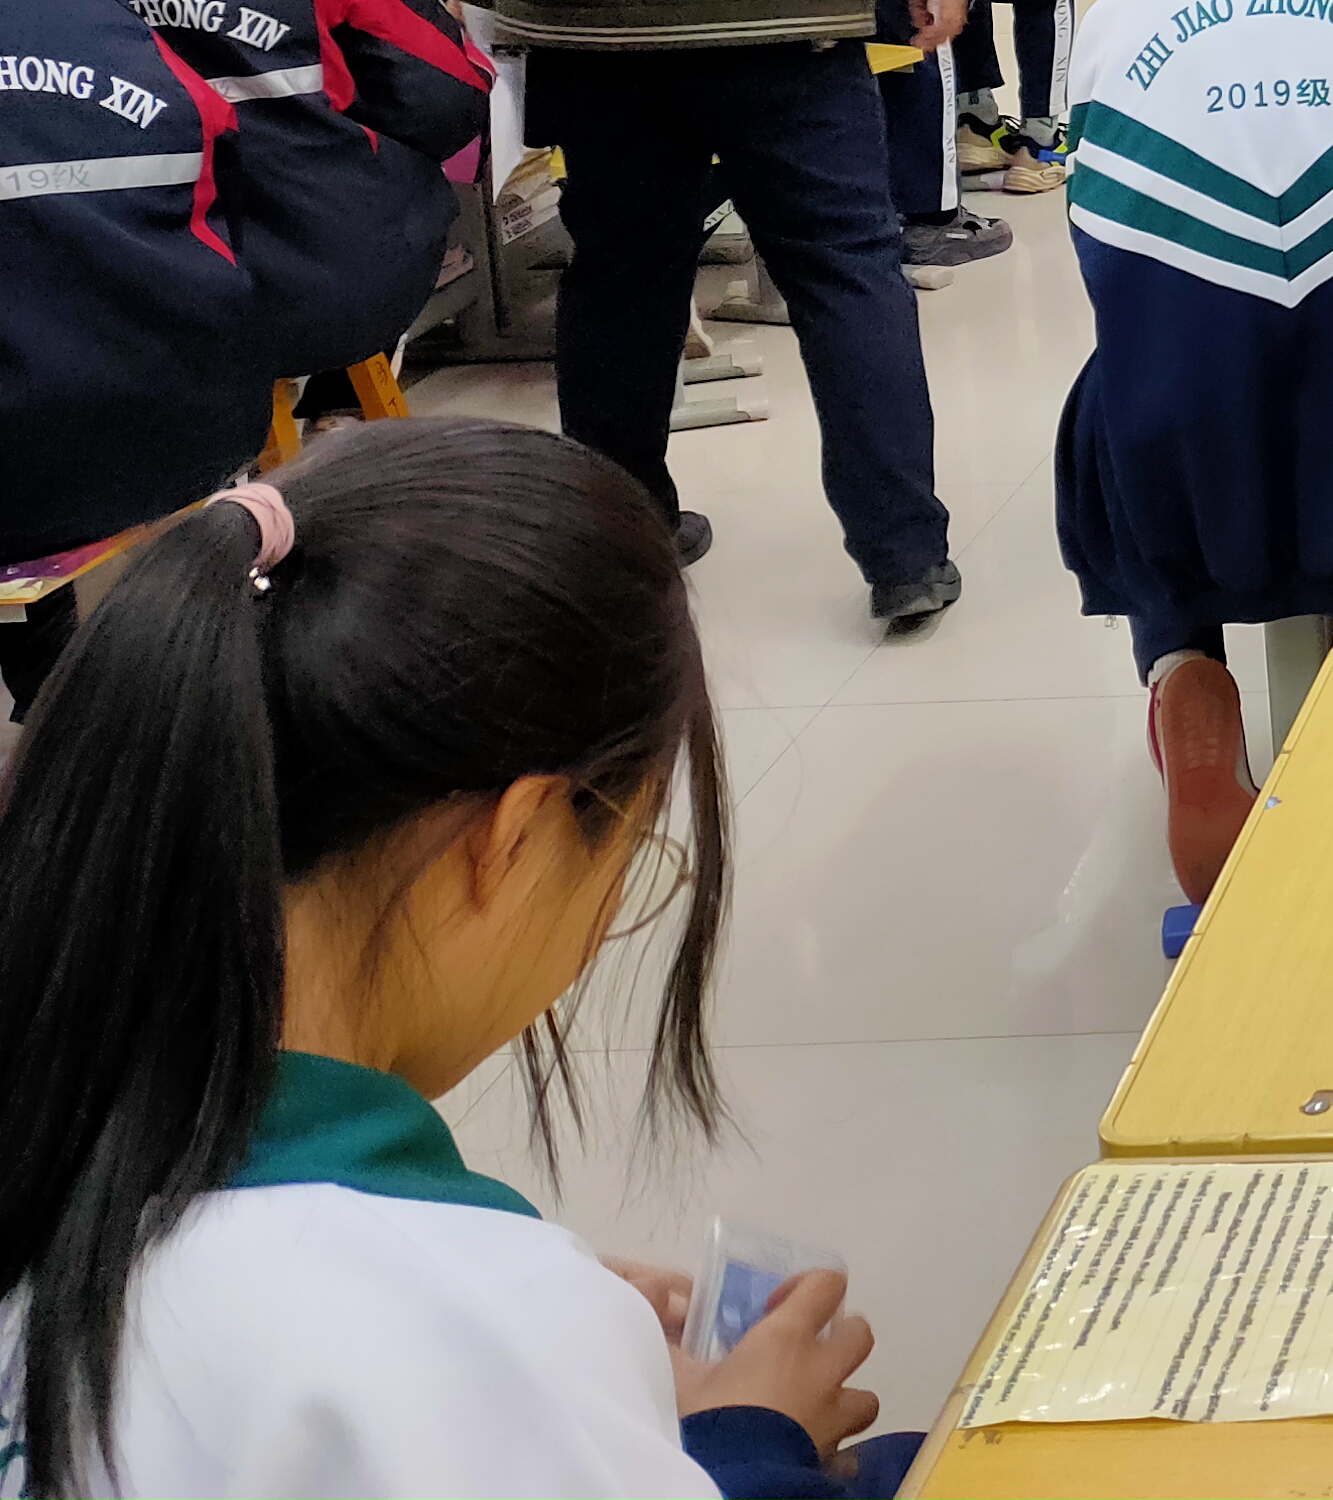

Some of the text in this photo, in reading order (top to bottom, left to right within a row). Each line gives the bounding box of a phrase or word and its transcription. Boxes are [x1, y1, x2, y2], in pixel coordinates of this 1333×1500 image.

[227, 7, 291, 52] XIN
[1125, 32, 1174, 91] ZHI
[99, 76, 168, 130] XIN
[1206, 78, 1332, 114] 2019级
